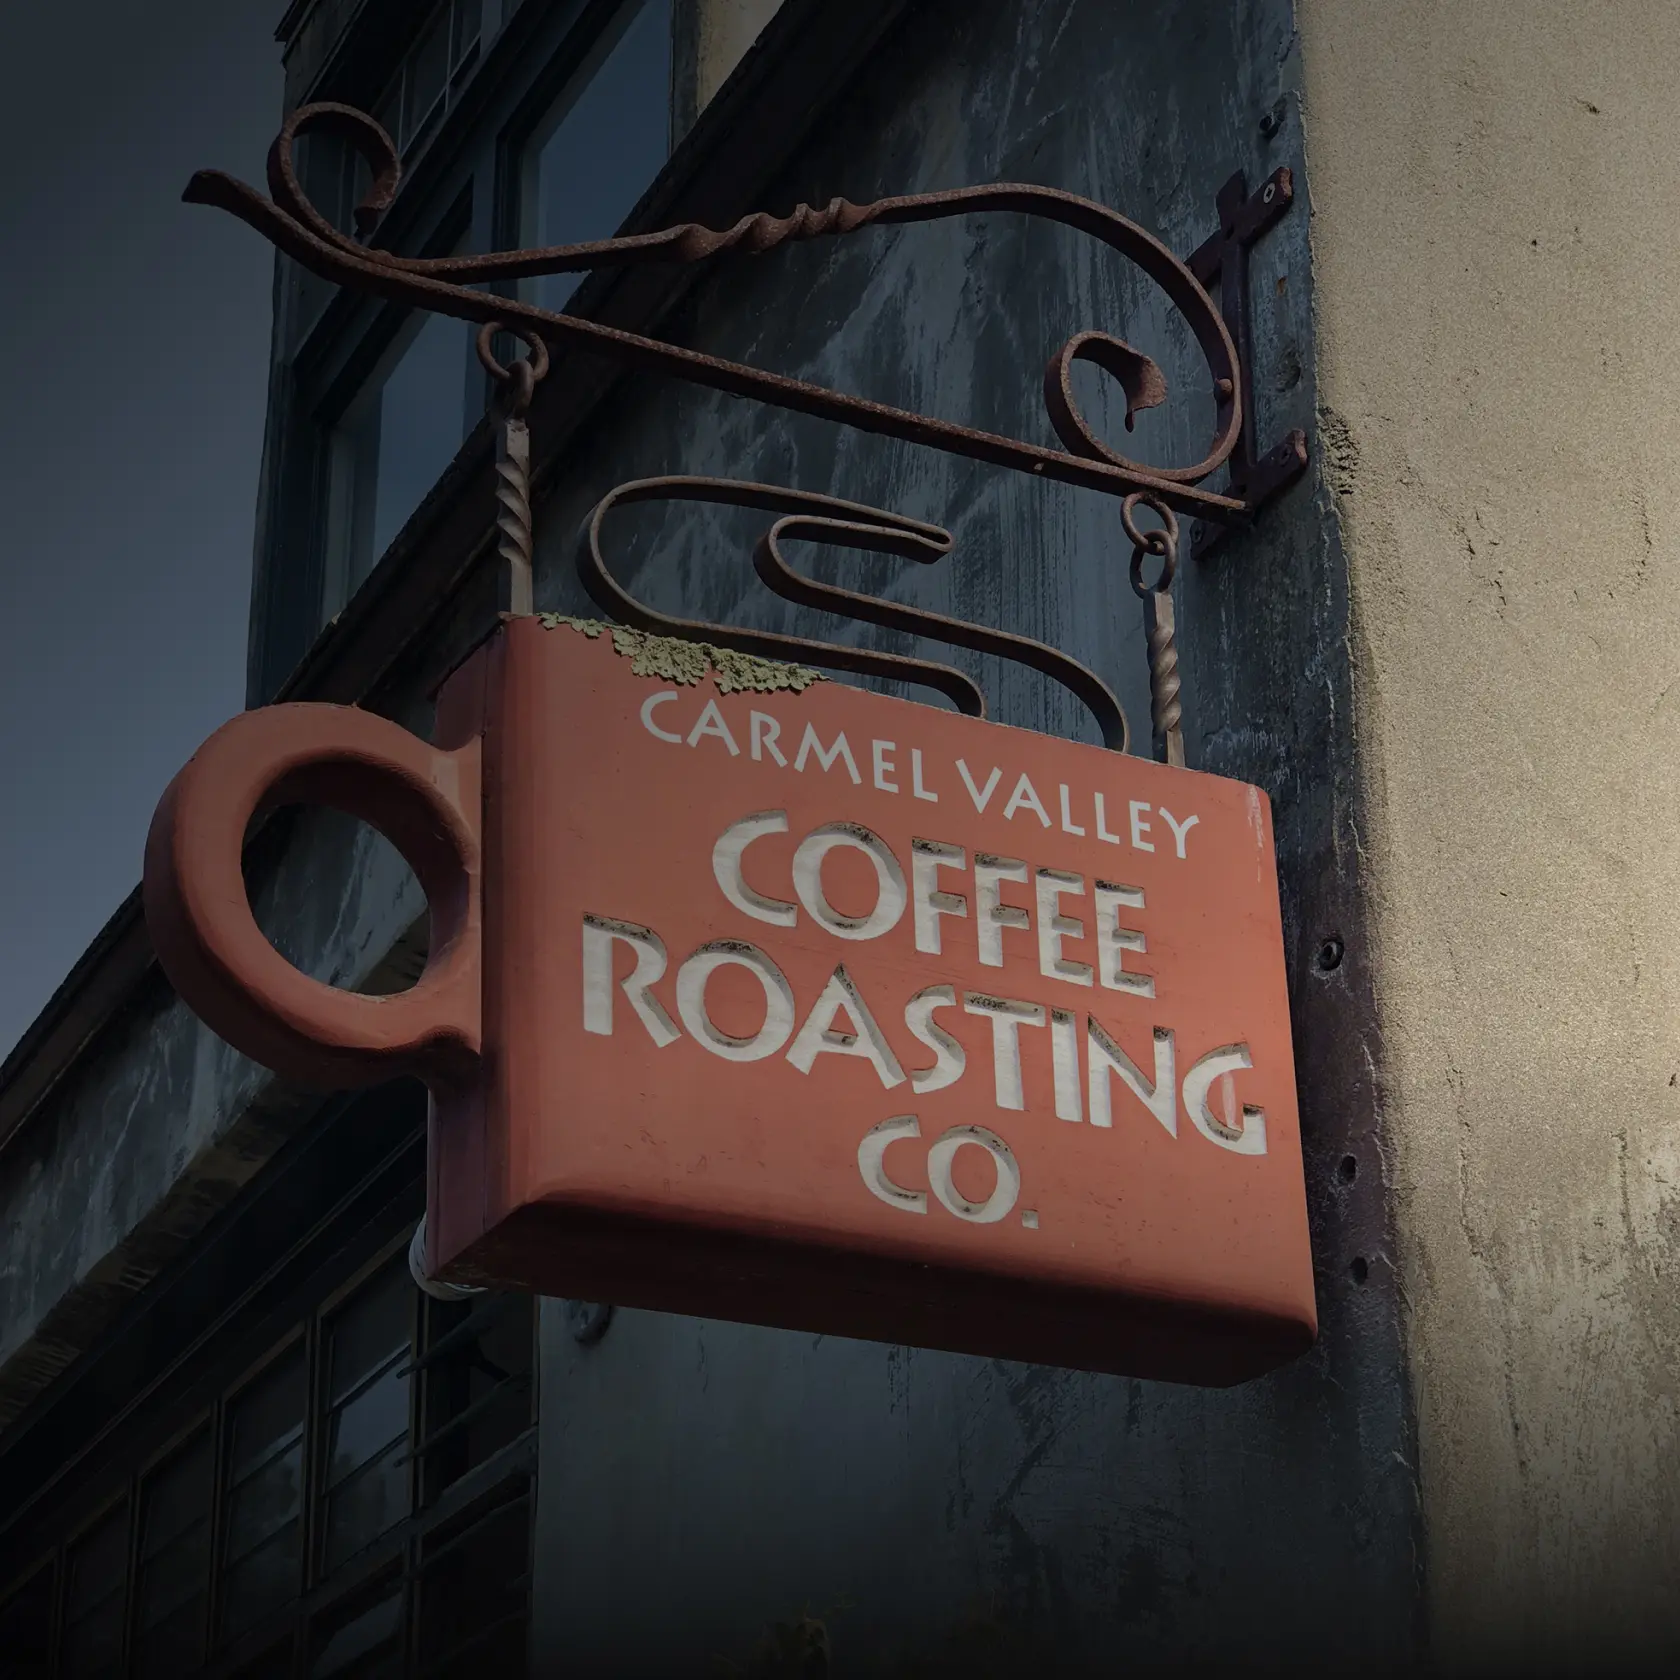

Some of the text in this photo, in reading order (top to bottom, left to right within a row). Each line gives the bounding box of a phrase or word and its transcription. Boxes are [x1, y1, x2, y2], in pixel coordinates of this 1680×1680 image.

[640, 690, 1200, 859] CARMEL VALLEY
[712, 809, 1156, 998] COFFEE
[582, 912, 1267, 1155] ROASTING
[857, 1114, 1039, 1229] CO.
